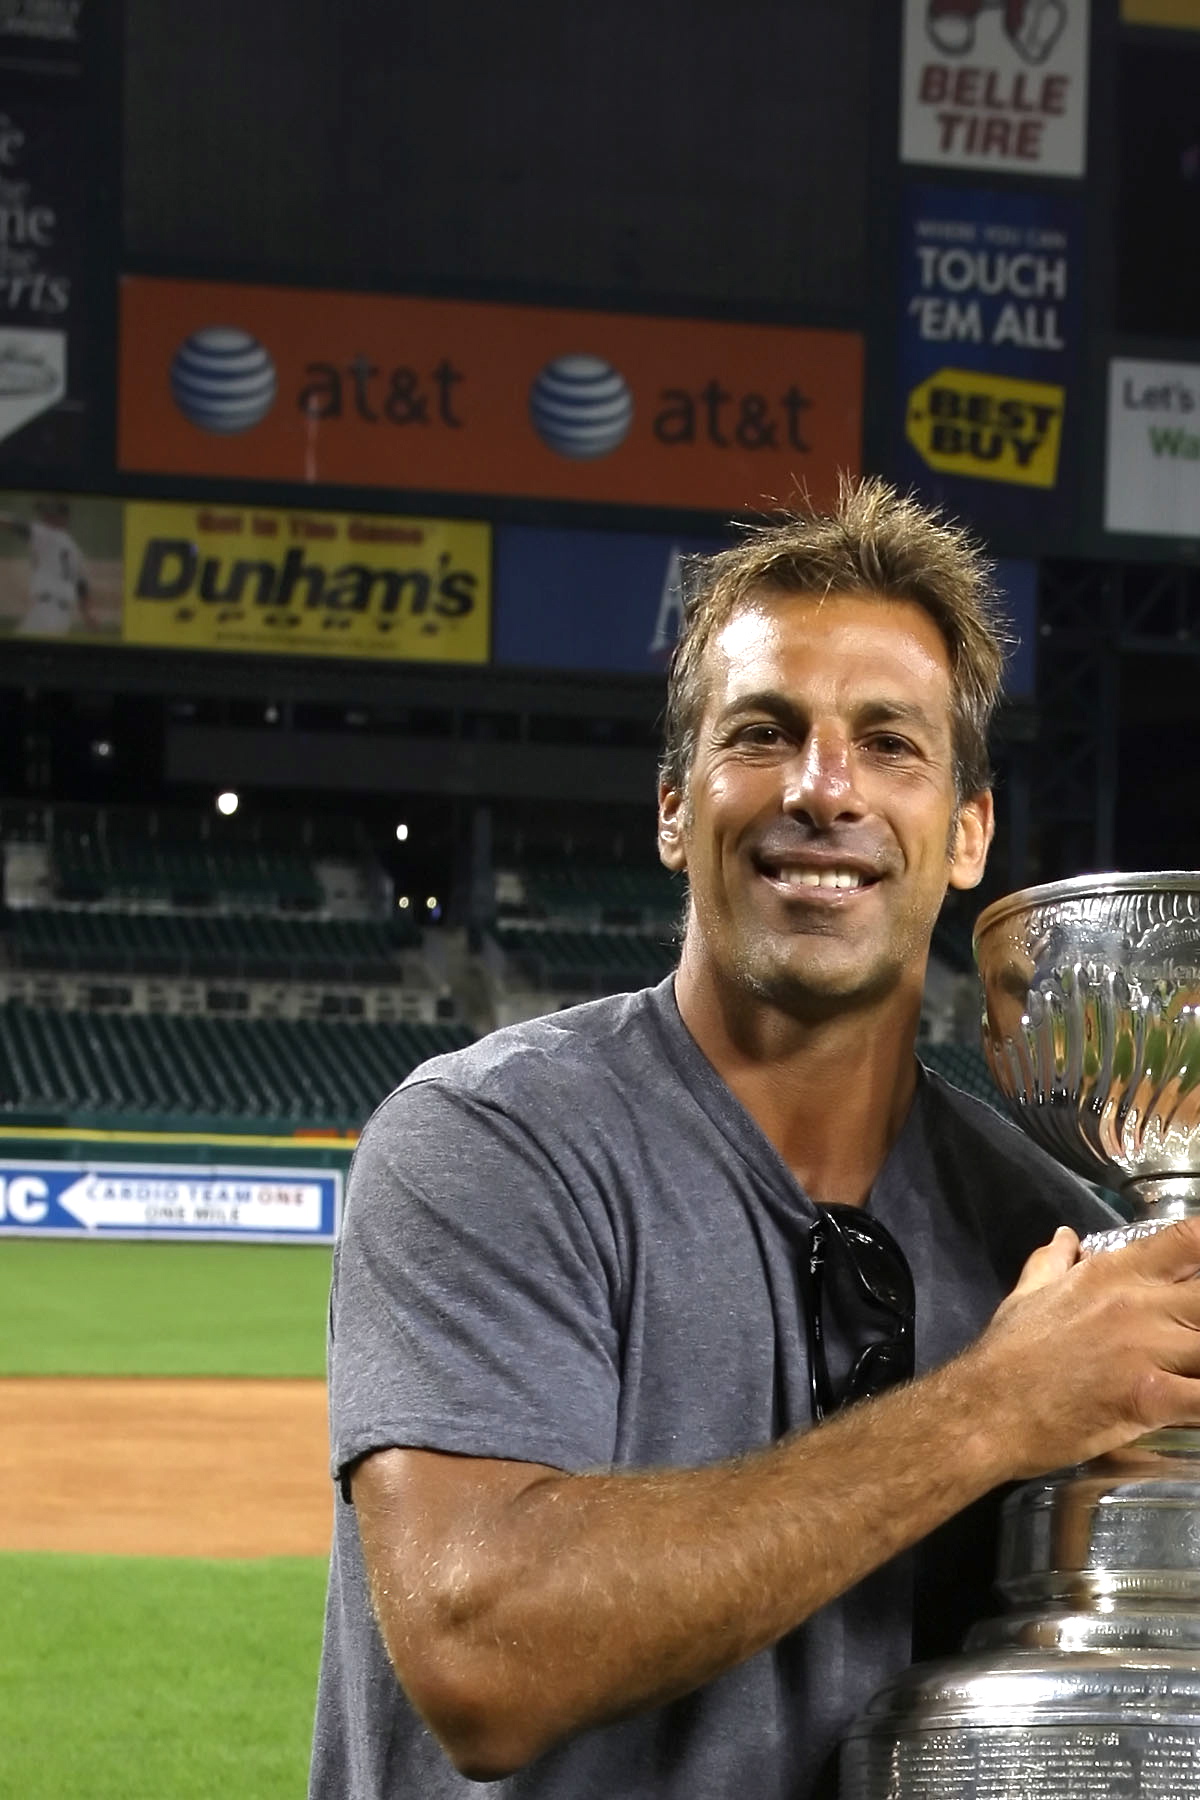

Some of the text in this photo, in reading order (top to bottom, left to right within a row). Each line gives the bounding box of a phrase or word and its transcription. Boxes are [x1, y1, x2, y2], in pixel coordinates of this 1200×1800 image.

[918, 64, 1070, 119] BELLE
[936, 110, 1046, 162] TIRE
[916, 247, 1067, 299] TOUCH
[909, 297, 1064, 351] 'EM ALL
[299, 354, 463, 428] at&t
[653, 378, 813, 453] at&t
[929, 387, 1058, 437] BEST
[1123, 379, 1195, 414] Let's
[930, 424, 1045, 470] BUY
[134, 536, 478, 620] Dunham's
[0, 1175, 48, 1223] C
[86, 1182, 306, 1207] CARDIO TEAM ONE
[144, 1205, 241, 1223] ONE MILE
